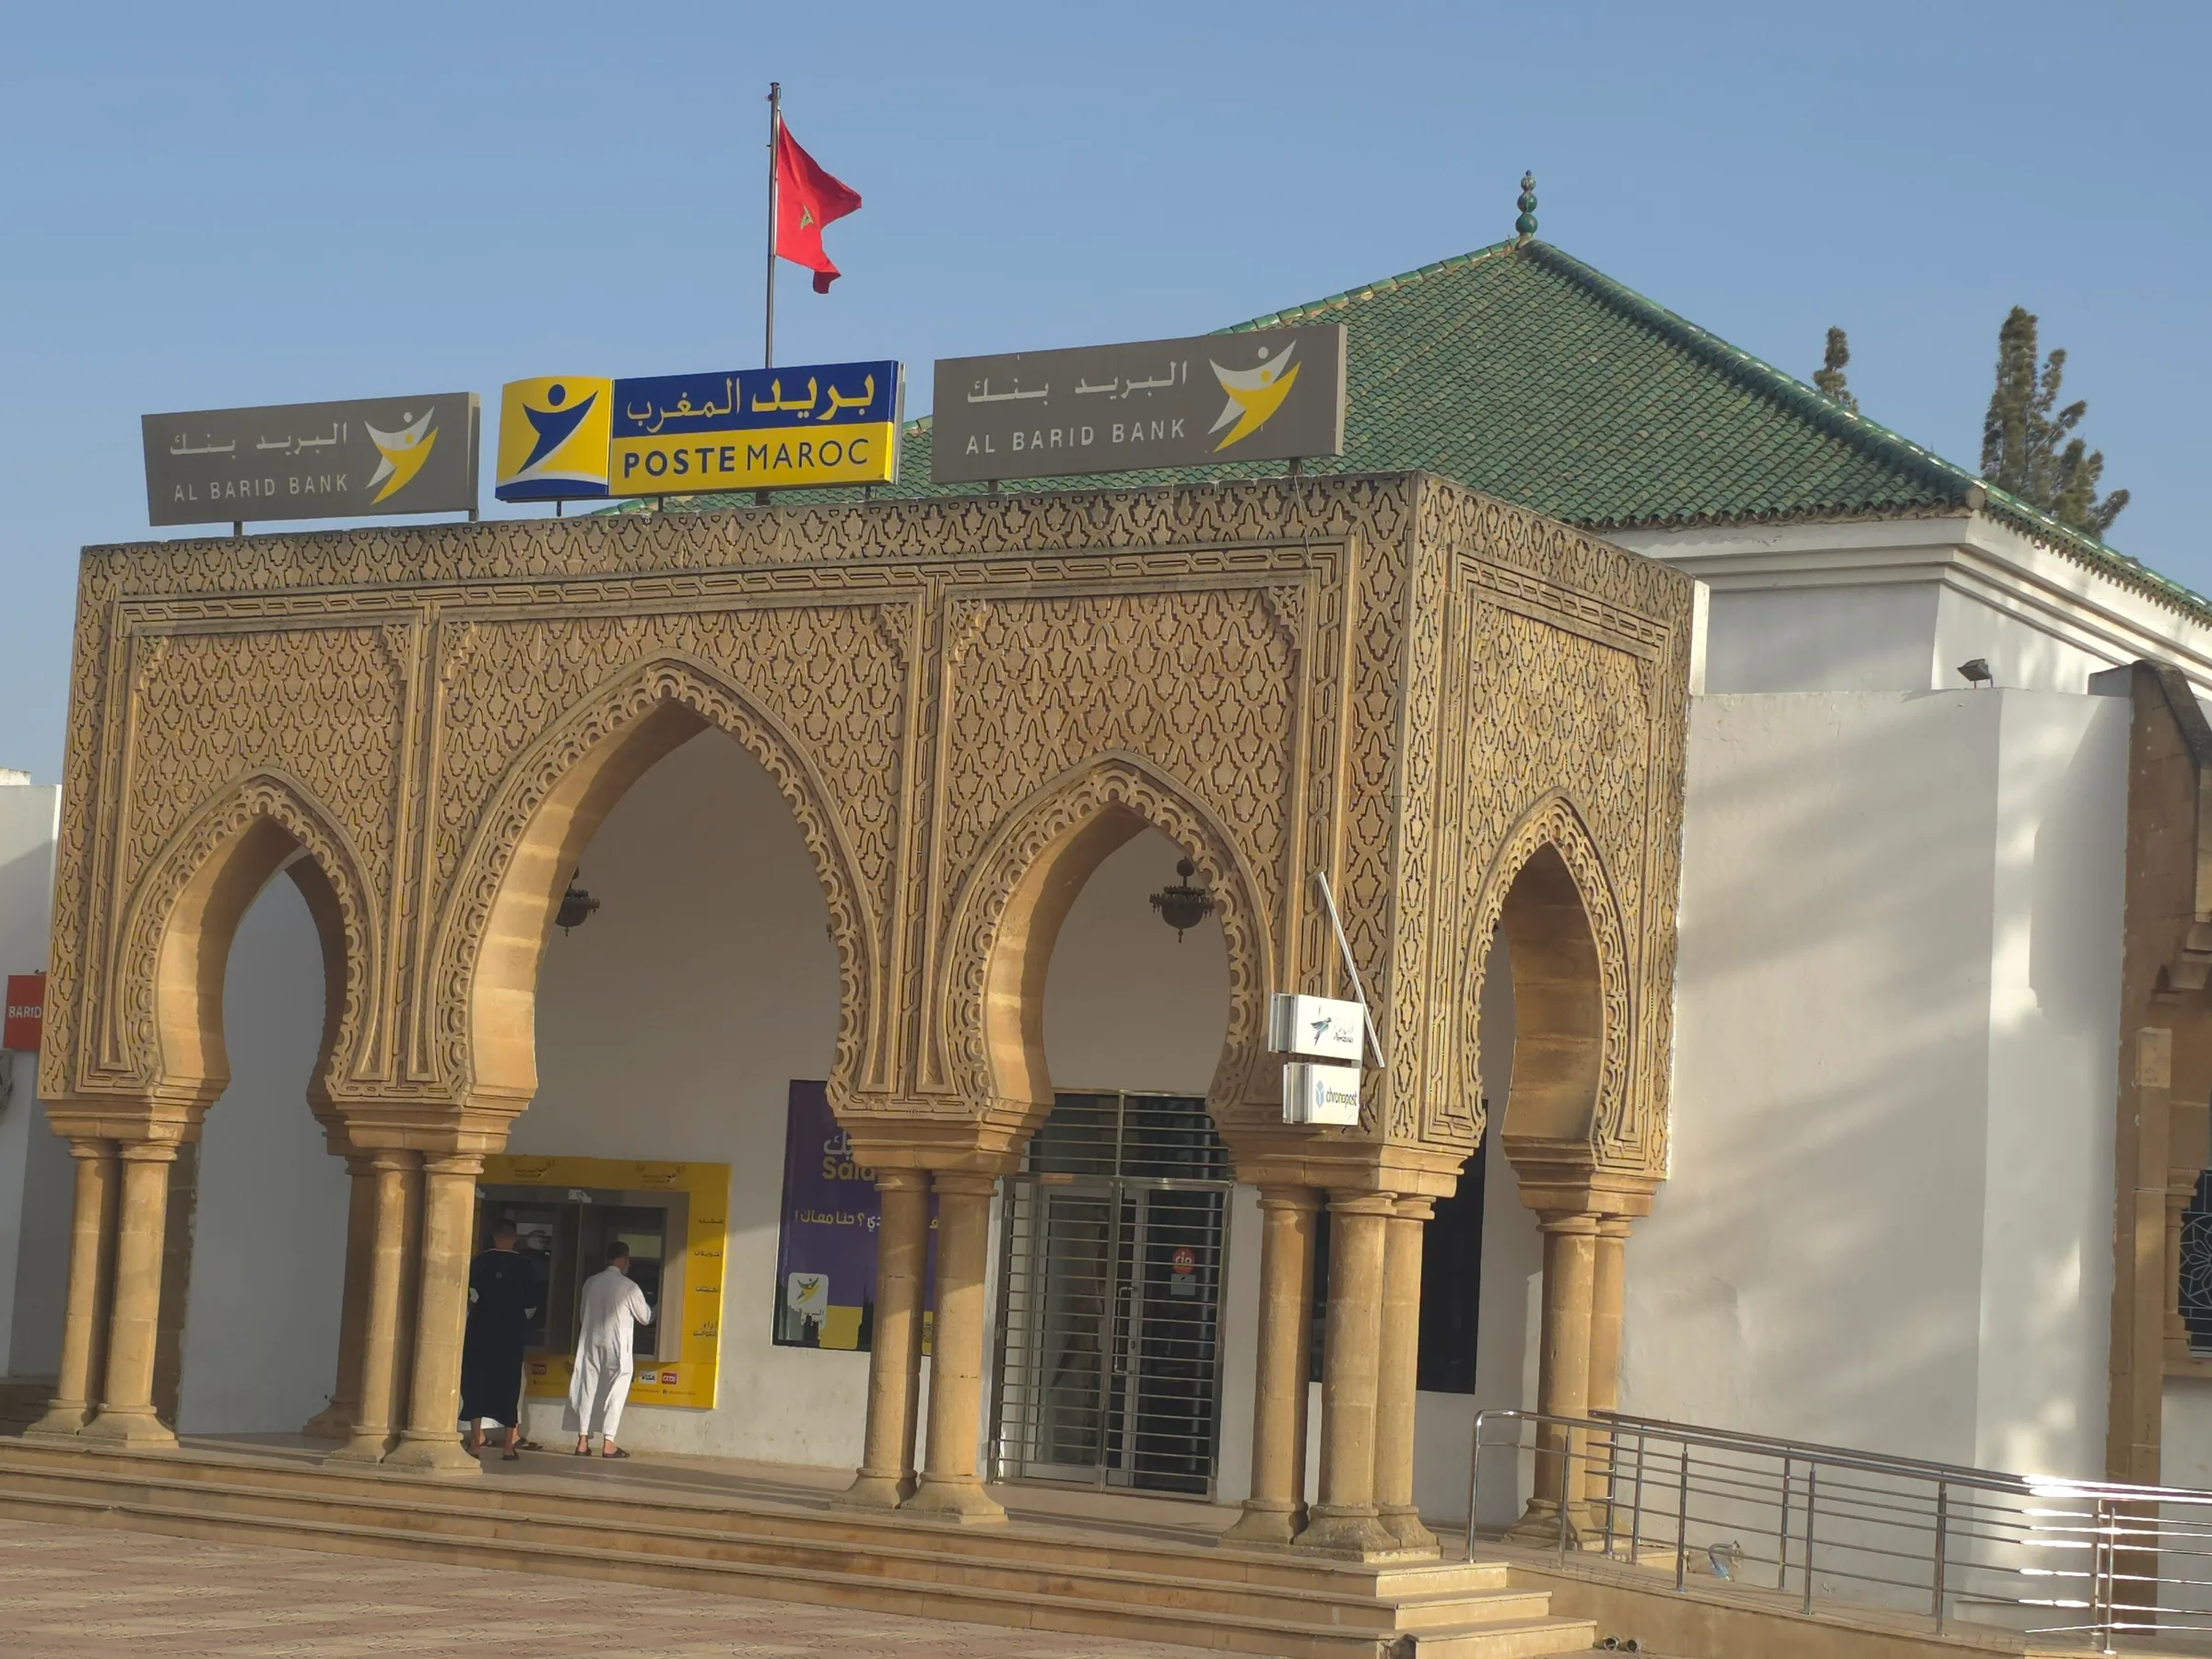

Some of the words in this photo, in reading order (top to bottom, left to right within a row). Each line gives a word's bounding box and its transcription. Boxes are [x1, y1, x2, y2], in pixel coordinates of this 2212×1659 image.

[750, 372, 875, 420] بريد
[967, 377, 1050, 406] بنك
[1075, 360, 1187, 400] البريد
[627, 377, 740, 433] المغرب
[170, 432, 236, 460] بنك
[256, 421, 347, 456] البريد
[966, 434, 996, 455] AL
[1013, 426, 1094, 452] BARID
[1112, 418, 1185, 443] BANK
[623, 445, 735, 478] POSTE
[747, 438, 869, 471] MAROC
[174, 480, 197, 502] AL
[211, 477, 276, 500] BARID
[289, 474, 348, 495] BANK
[8, 1006, 42, 1018] BARID
